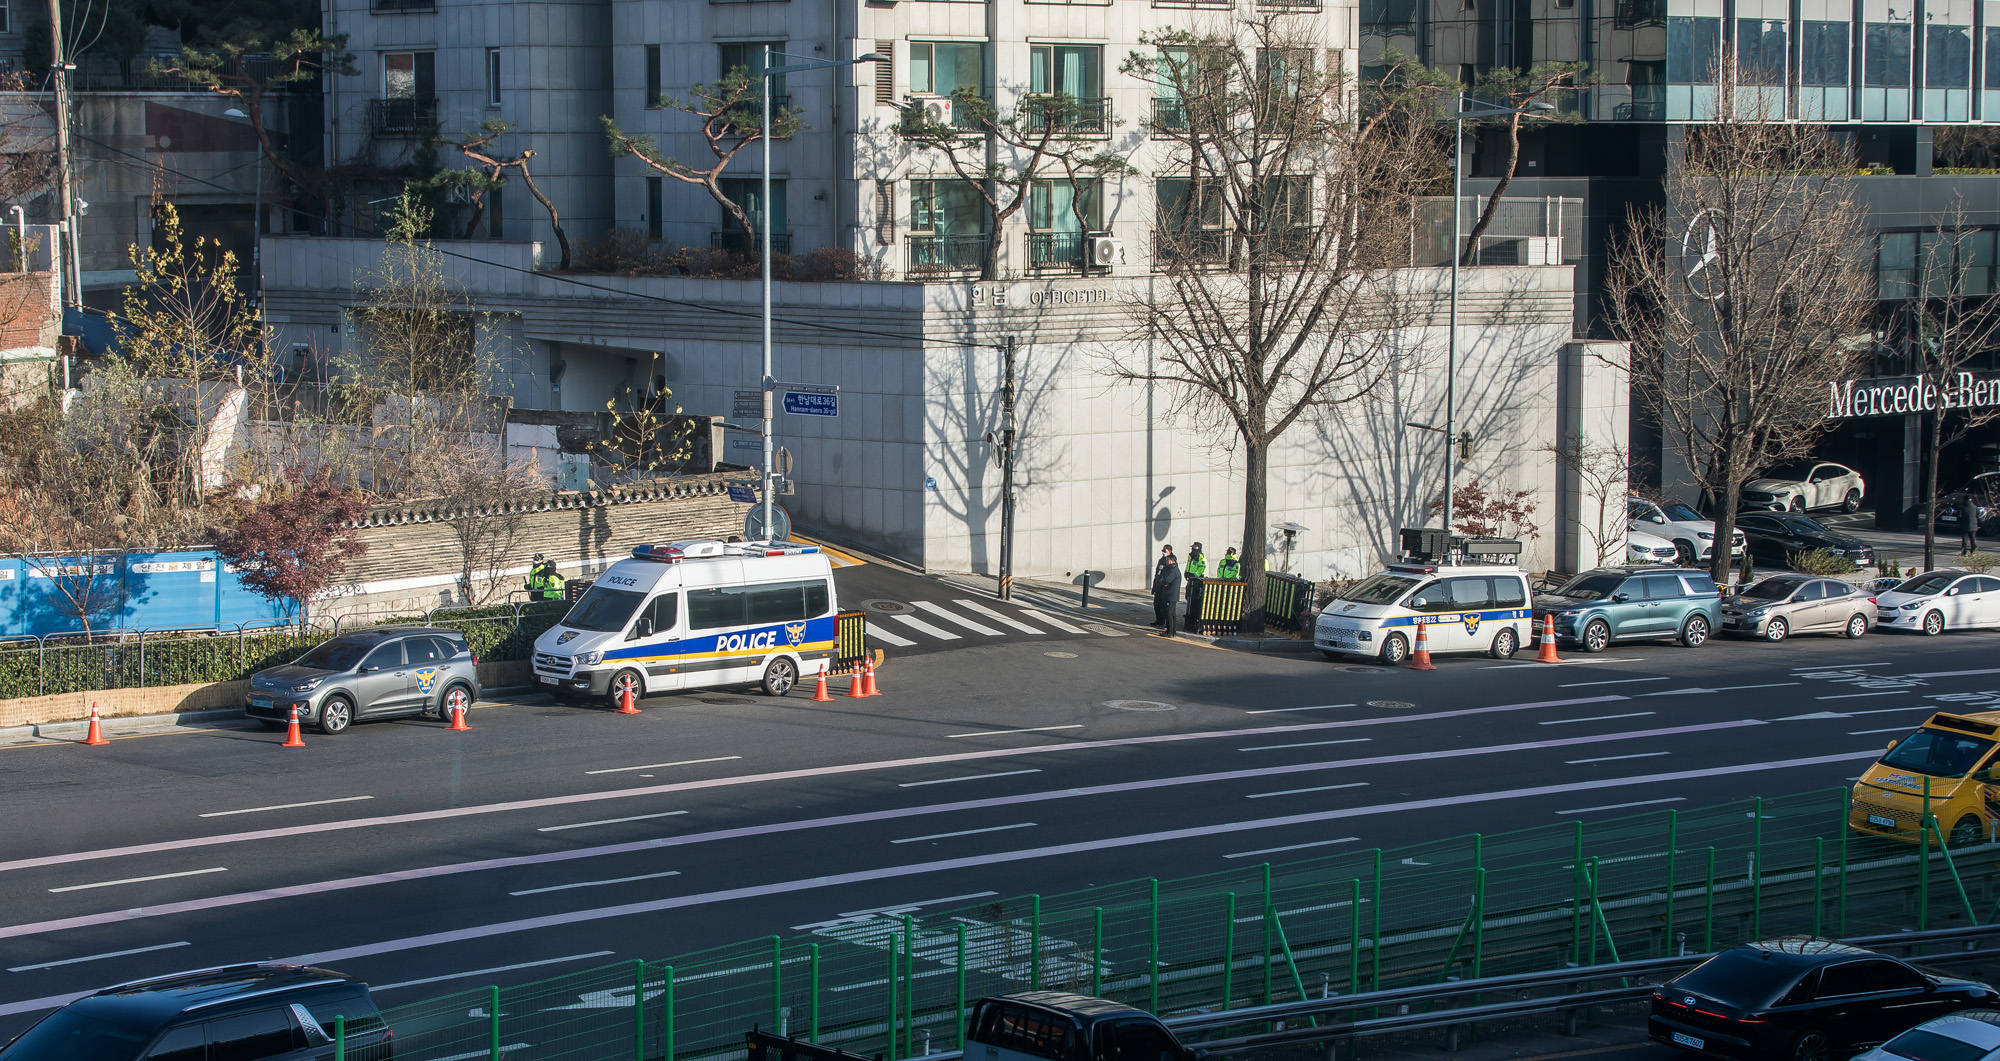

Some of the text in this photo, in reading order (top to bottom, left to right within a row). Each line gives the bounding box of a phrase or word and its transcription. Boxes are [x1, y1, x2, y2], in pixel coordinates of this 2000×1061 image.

[971, 285, 1113, 306] 한남 OFFICETEL
[797, 394, 836, 408] 한남대로36길
[790, 405, 836, 416] Hannam-daero 36-gil
[141, 561, 206, 573] 안전 제일
[607, 575, 638, 587] POLICE
[715, 630, 777, 653] POLICE
